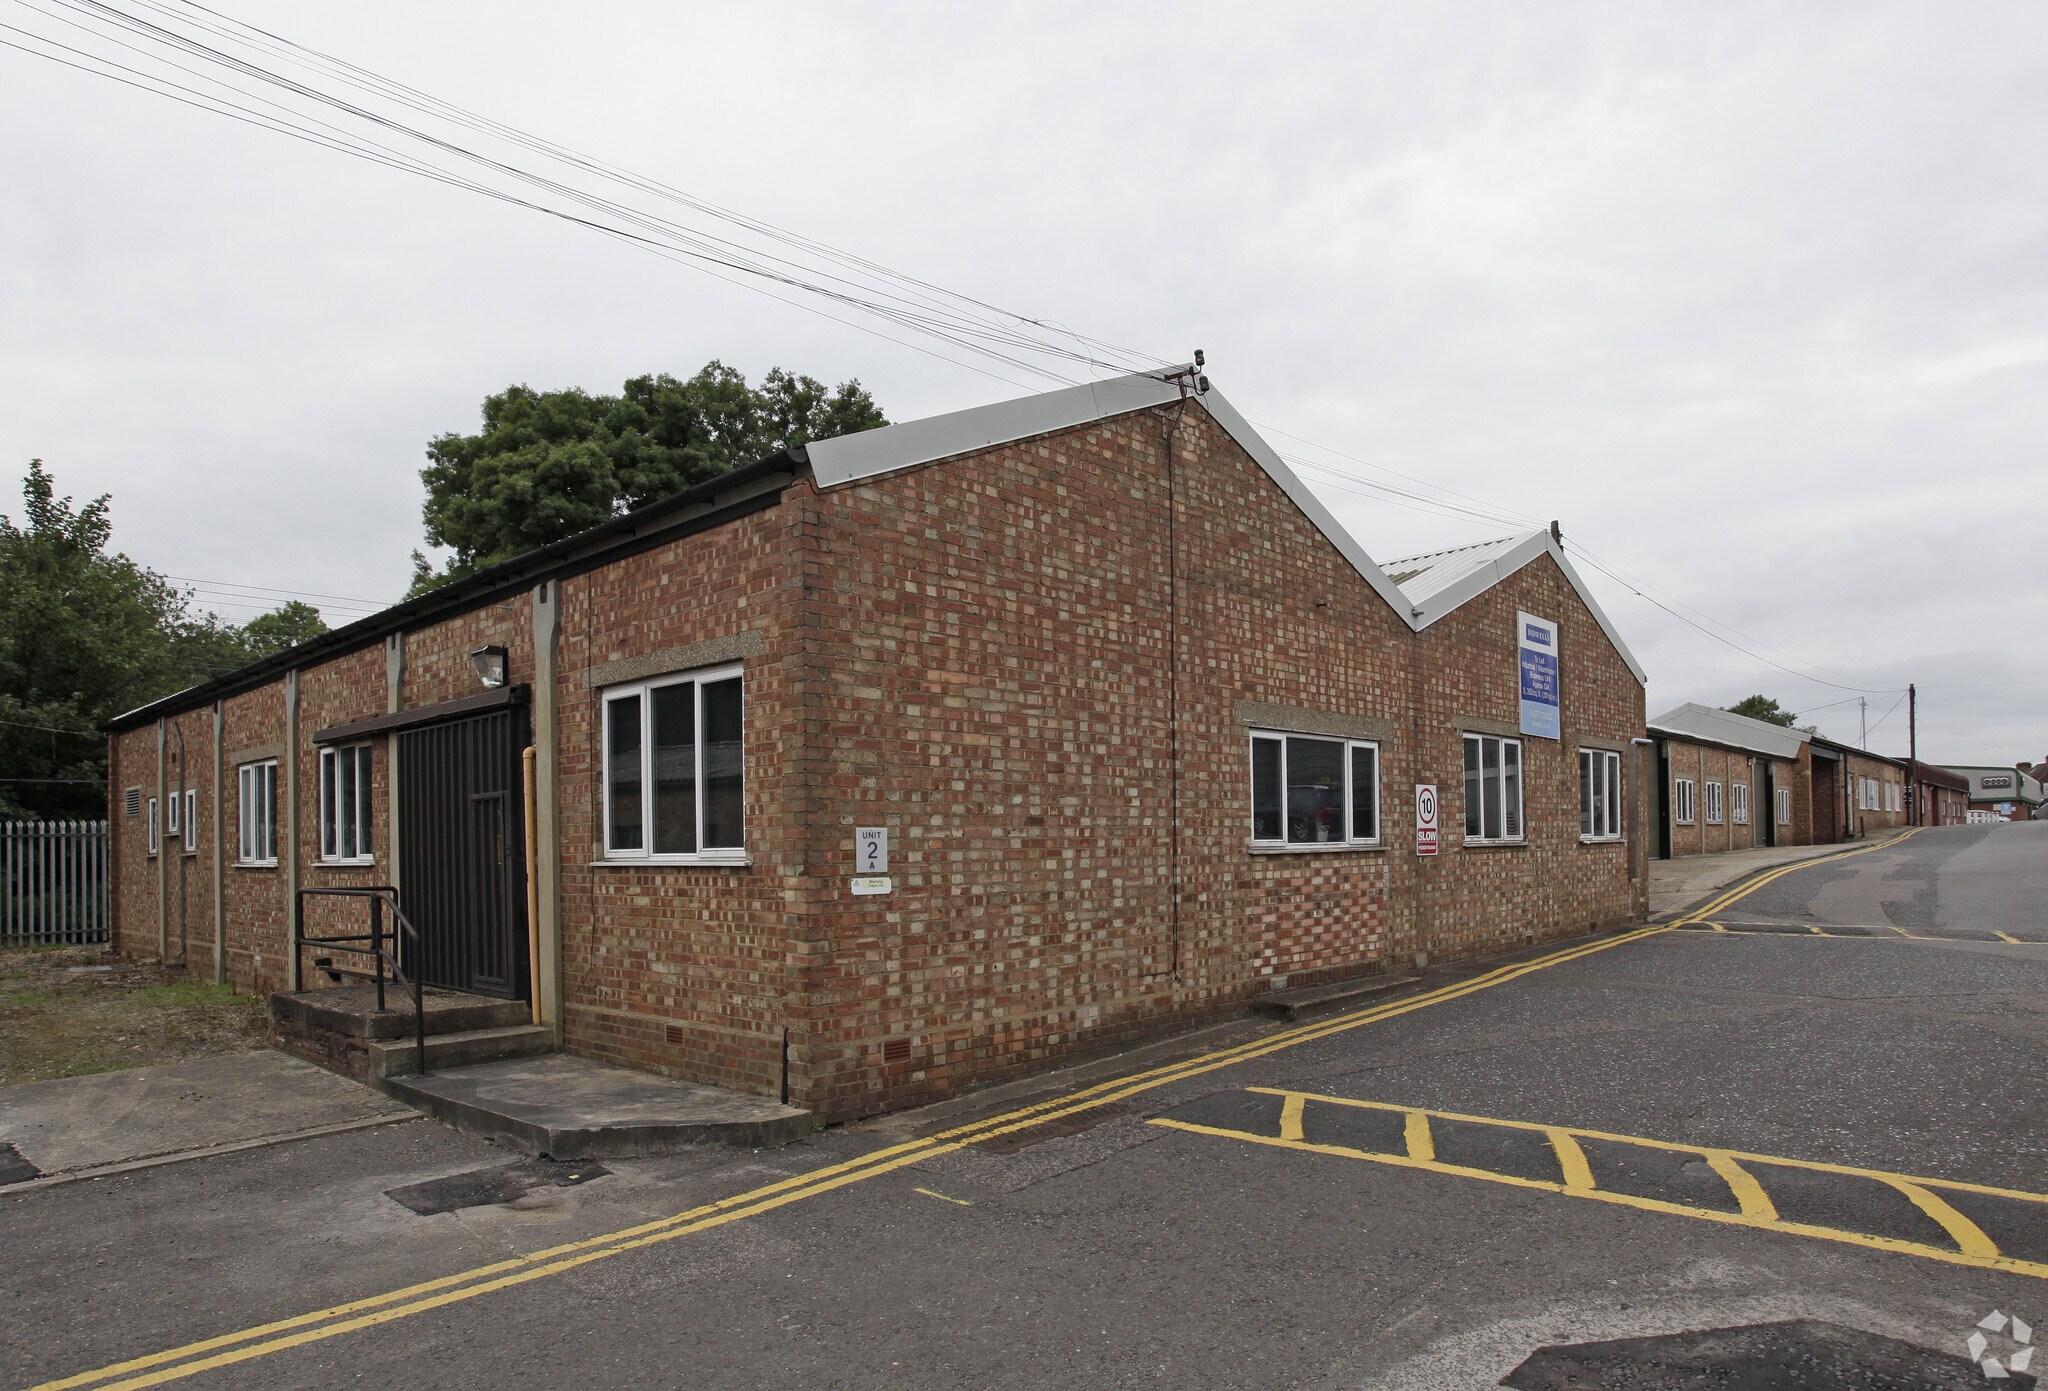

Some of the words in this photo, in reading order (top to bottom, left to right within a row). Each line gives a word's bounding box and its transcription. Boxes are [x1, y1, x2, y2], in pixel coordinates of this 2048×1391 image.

[1528, 629, 1549, 641] BIDWELLS
[1422, 798, 1432, 814] 10
[862, 831, 882, 839] UNIT
[1418, 831, 1436, 841] SLOW
[867, 841, 878, 859] 2
[869, 861, 875, 869] A
